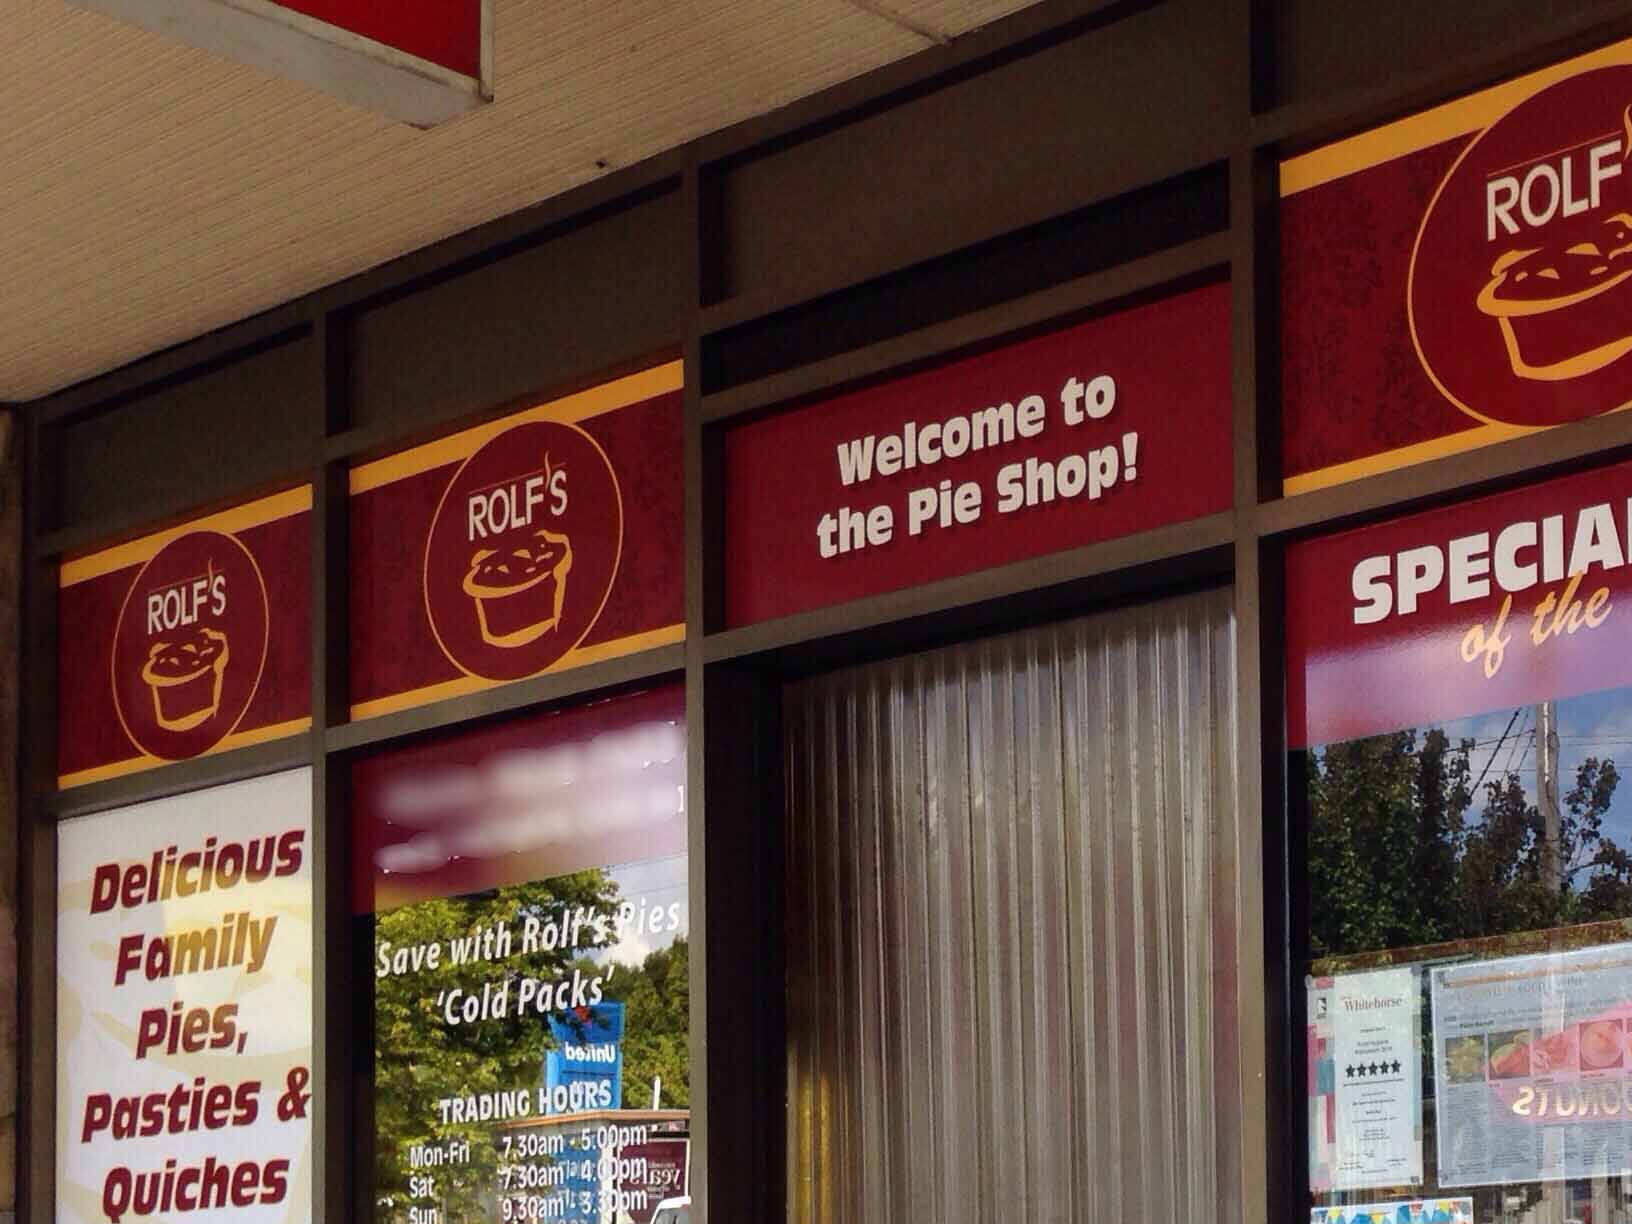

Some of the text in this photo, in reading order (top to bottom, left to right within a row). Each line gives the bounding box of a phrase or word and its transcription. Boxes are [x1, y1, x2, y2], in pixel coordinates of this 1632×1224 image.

[837, 375, 1115, 486] Welcome to
[467, 464, 568, 541] ROLF'S
[816, 431, 1139, 559] the Pie Shop!
[147, 564, 226, 634] ROLF'S
[1461, 594, 1513, 678] of
[1529, 568, 1613, 646] the
[90, 828, 305, 915] Delicious
[115, 910, 278, 987] Family
[376, 900, 680, 979] Save with Rolf's Pies
[136, 1000, 249, 1060] Pies,
[437, 965, 615, 1026] 'Cold Packs'
[81, 1066, 311, 1143] Pasties &
[439, 1079, 612, 1126] TRADING HOURS
[409, 1140, 470, 1169] Mon-Fri
[501, 1132, 565, 1159] 7.30am
[580, 1123, 648, 1153] 5.00pm
[409, 1174, 434, 1199] Sat
[501, 1163, 565, 1190] 7.30am
[580, 1155, 648, 1185] 4.00pm
[502, 1196, 565, 1223] 9.30am
